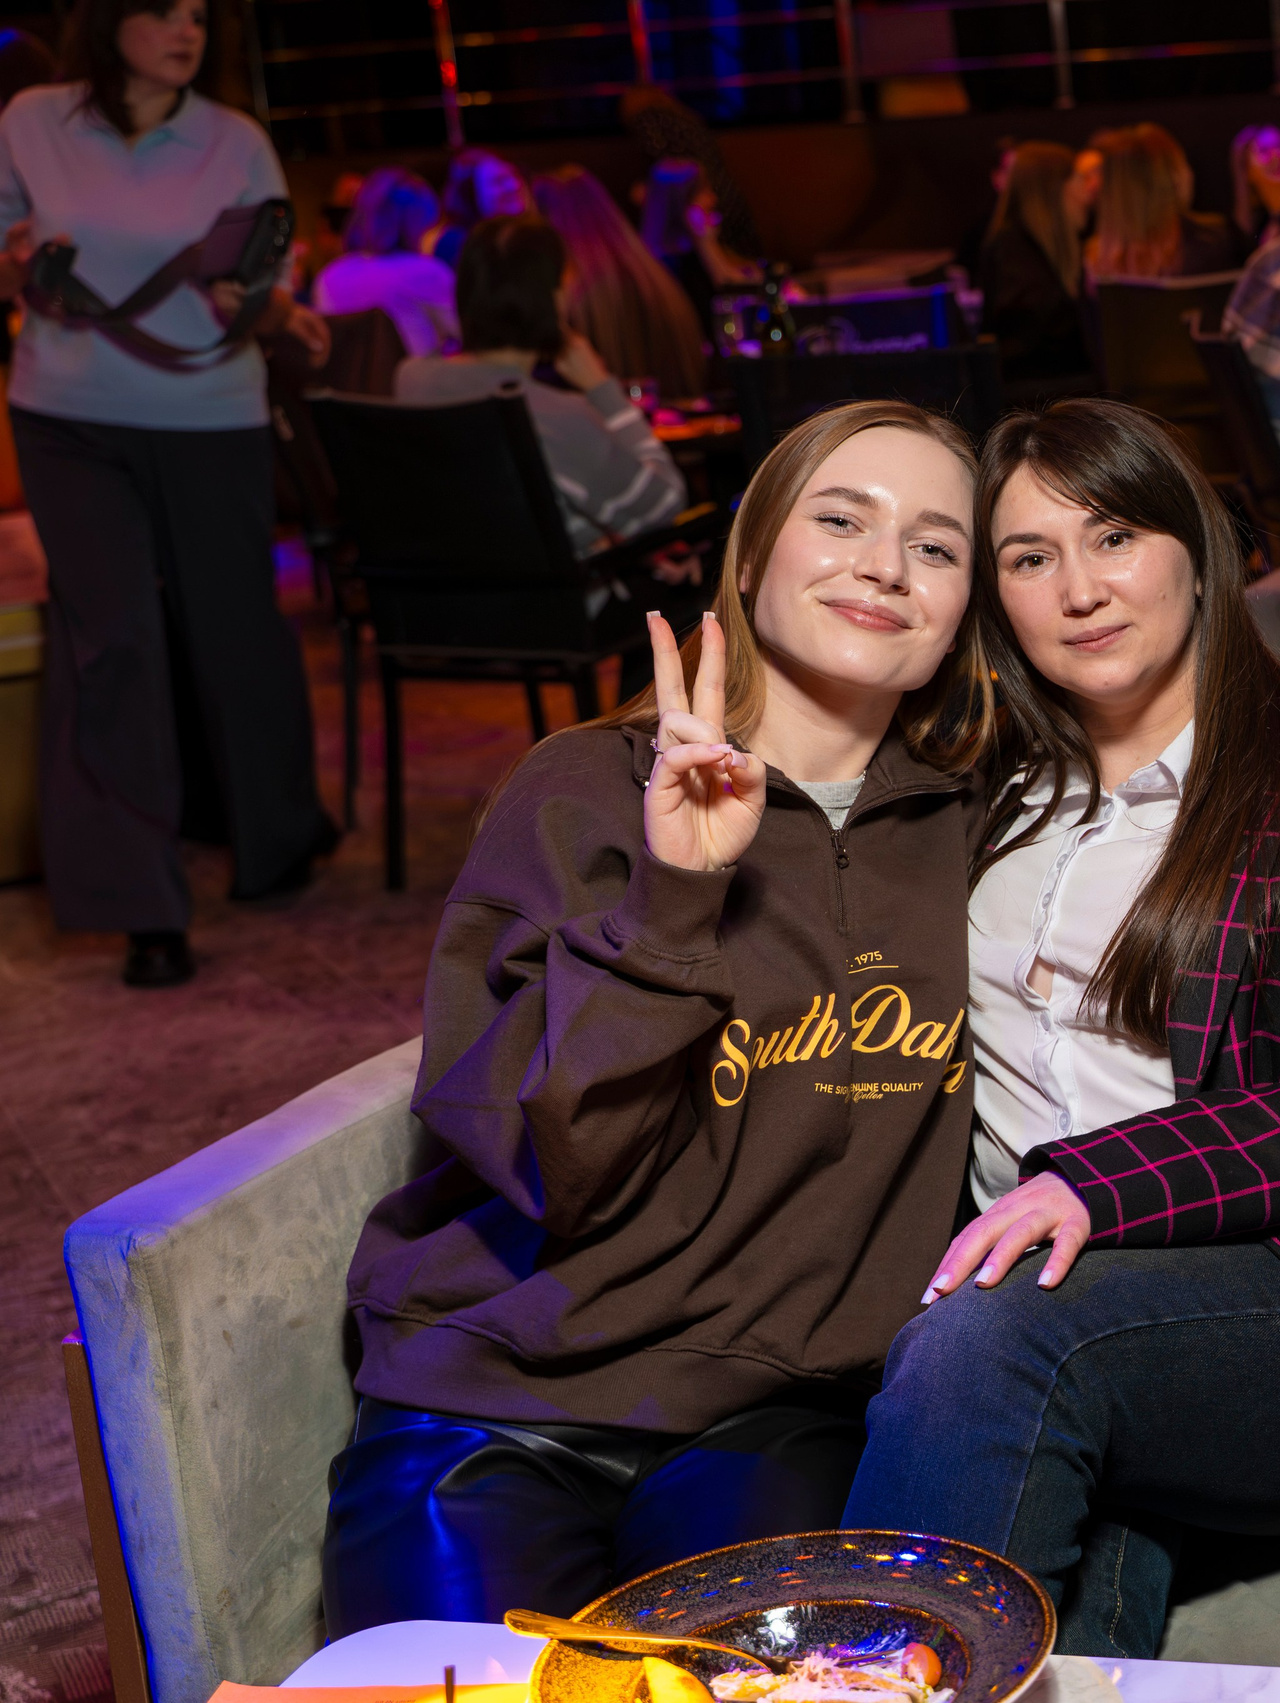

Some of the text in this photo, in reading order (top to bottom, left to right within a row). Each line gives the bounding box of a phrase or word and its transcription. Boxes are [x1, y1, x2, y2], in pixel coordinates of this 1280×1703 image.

[854, 950, 883, 966] 1975
[814, 1082, 834, 1094] THE
[881, 1082, 924, 1093] QUALITY
